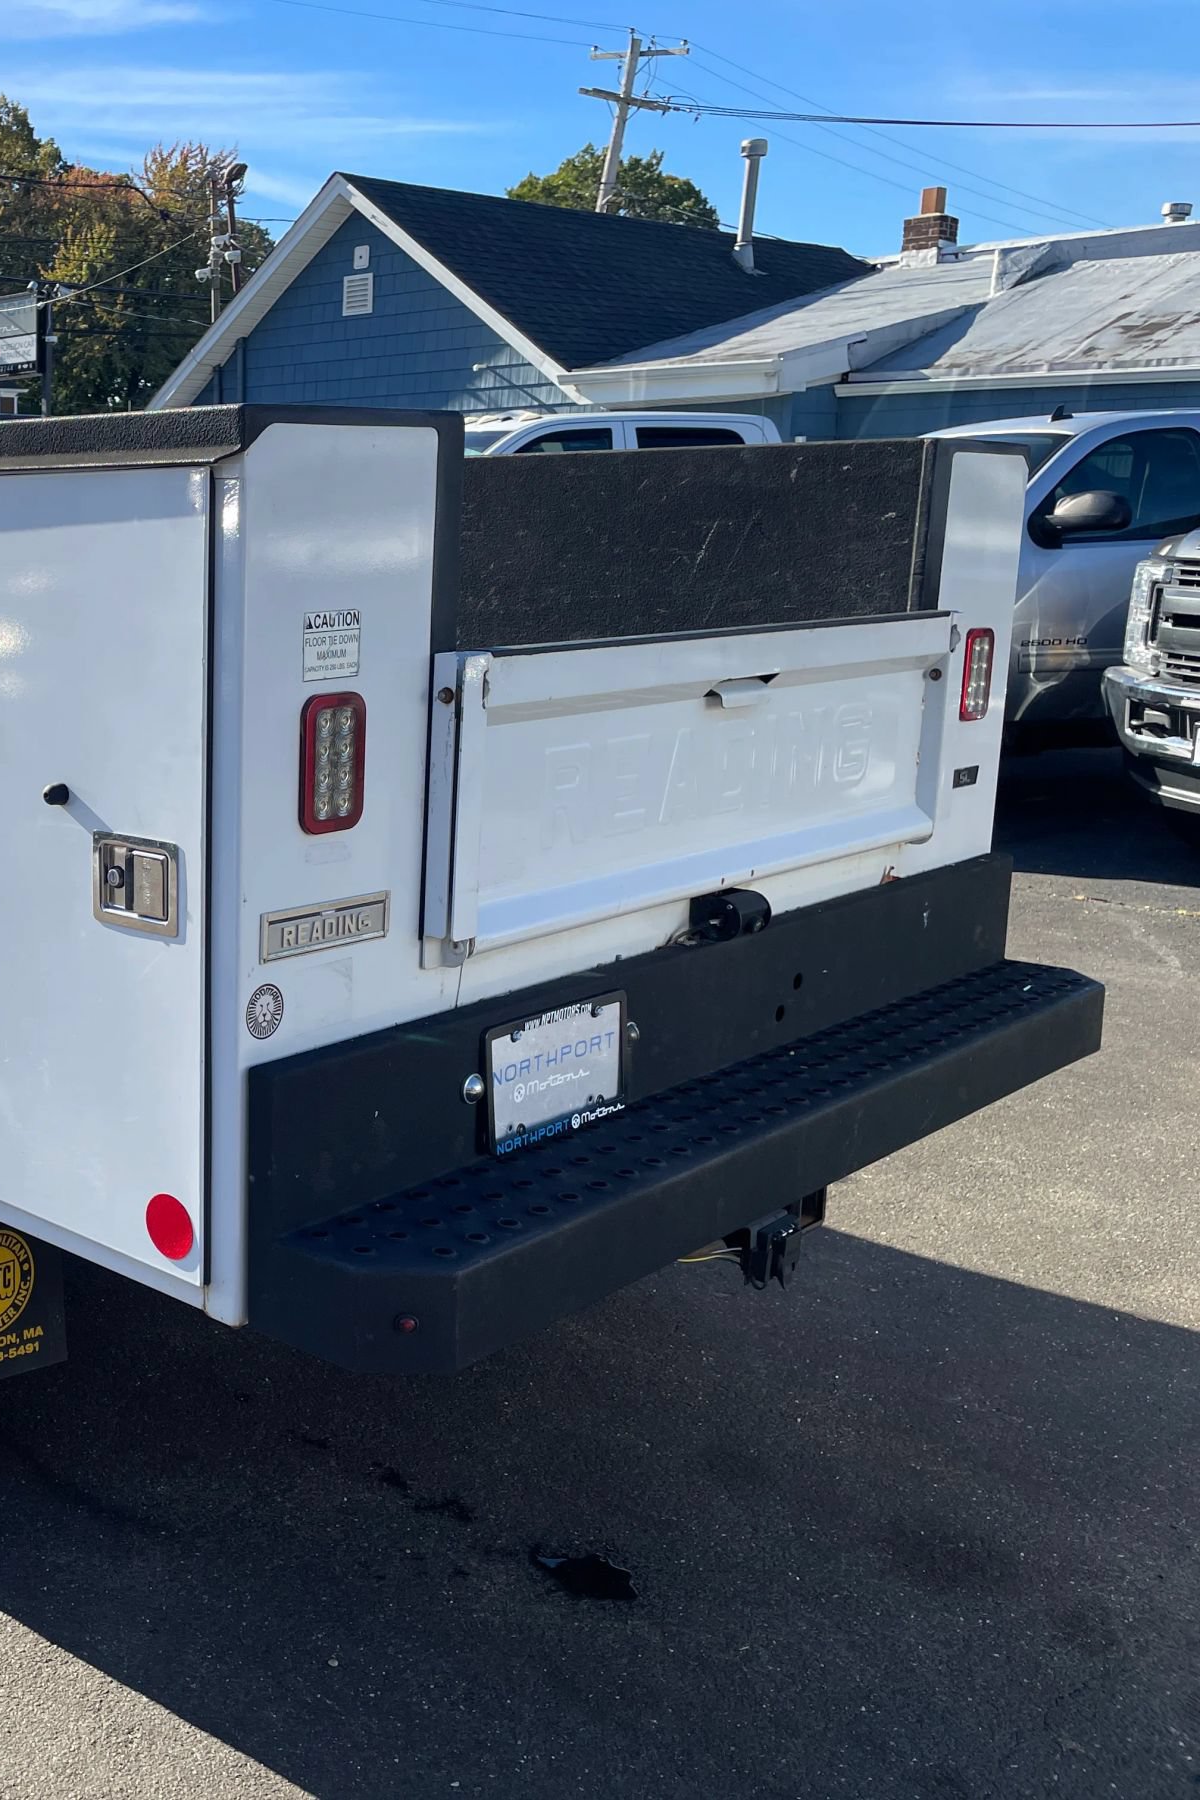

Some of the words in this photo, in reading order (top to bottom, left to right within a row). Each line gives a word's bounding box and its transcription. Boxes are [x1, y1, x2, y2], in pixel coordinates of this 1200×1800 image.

[313, 611, 360, 629] CAUTION
[305, 637, 326, 647] FLOOR
[328, 635, 338, 646] TIE
[339, 634, 358, 644] DOWN
[1020, 638, 1062, 647] 2500
[1065, 637, 1088, 646] HD
[317, 649, 347, 660] MAXIMUM
[541, 704, 873, 848] READING
[280, 911, 372, 948] READING
[250, 985, 282, 1008] RODMAN
[493, 1031, 615, 1086] NORTHPORT
[496, 1118, 570, 1156] NORTHPORT
[15, 1276, 31, 1308] INC.
[23, 1325, 44, 1341] MA
